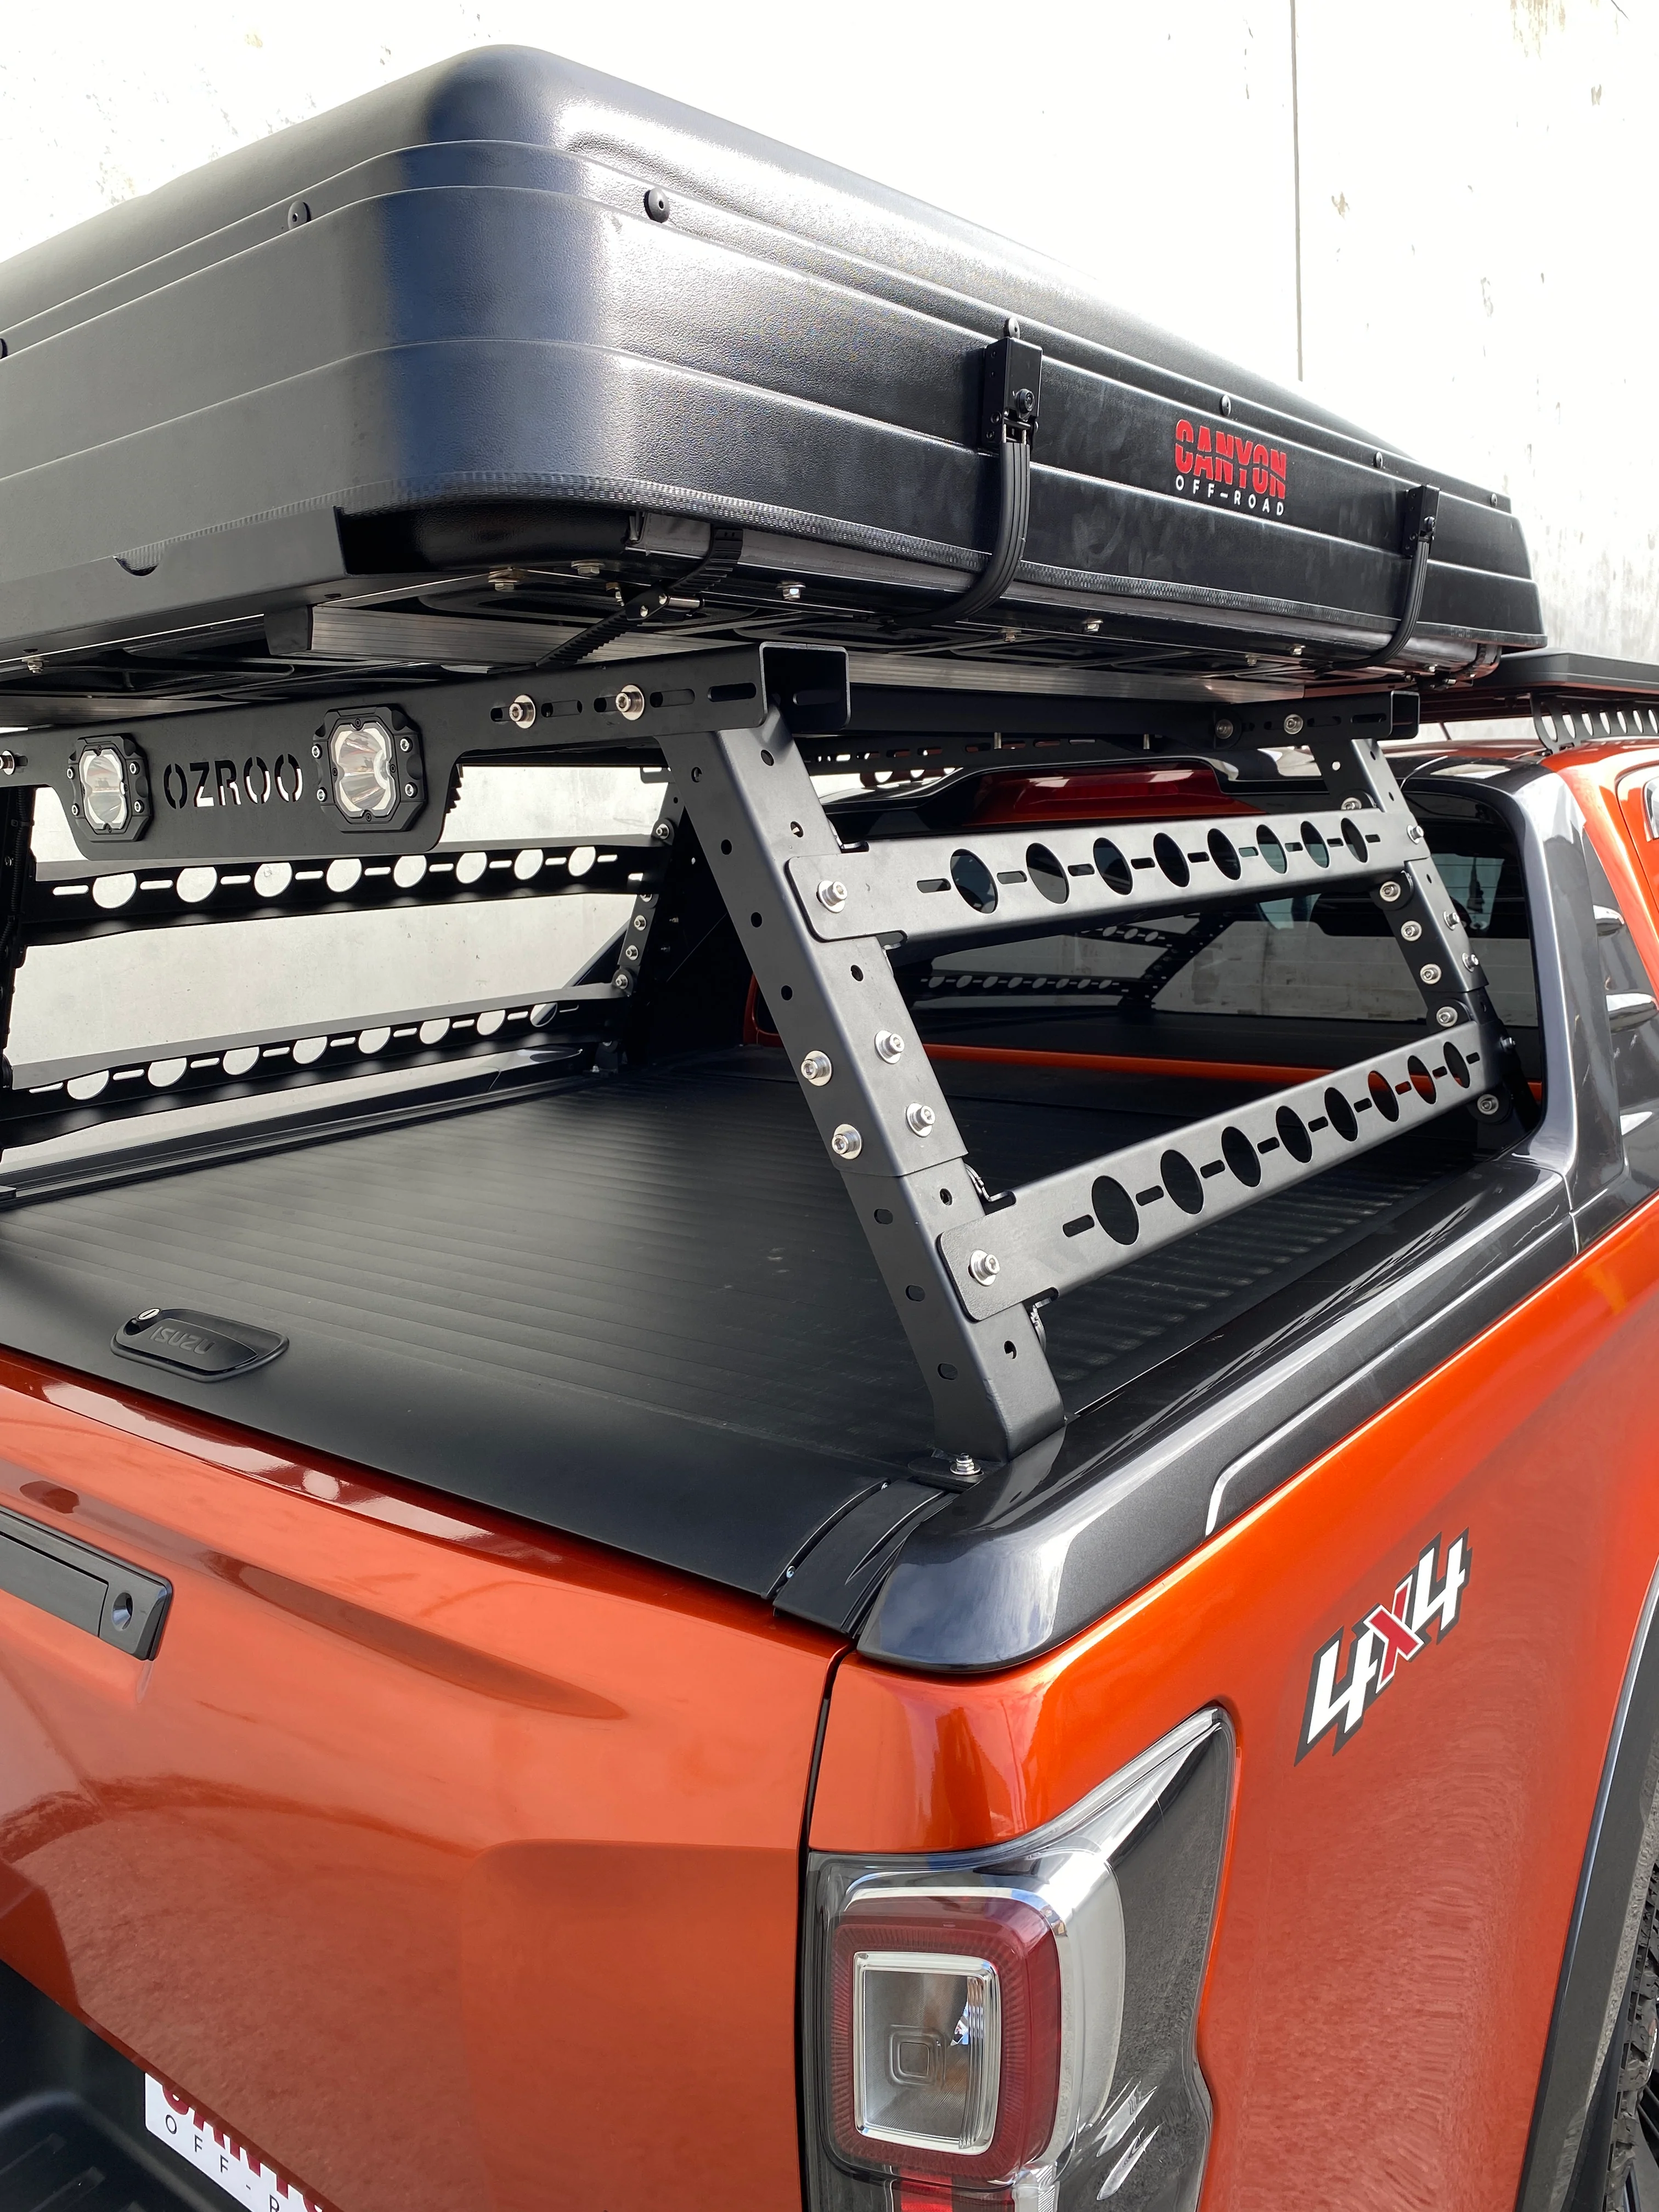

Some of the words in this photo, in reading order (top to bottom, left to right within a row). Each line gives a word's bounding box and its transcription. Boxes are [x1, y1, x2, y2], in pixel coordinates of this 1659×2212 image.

[1175, 419, 1286, 499] CANYON
[1176, 475, 1284, 516] OFF-ROAD
[163, 754, 303, 809] OZROO
[149, 1326, 215, 1355] ISUZU
